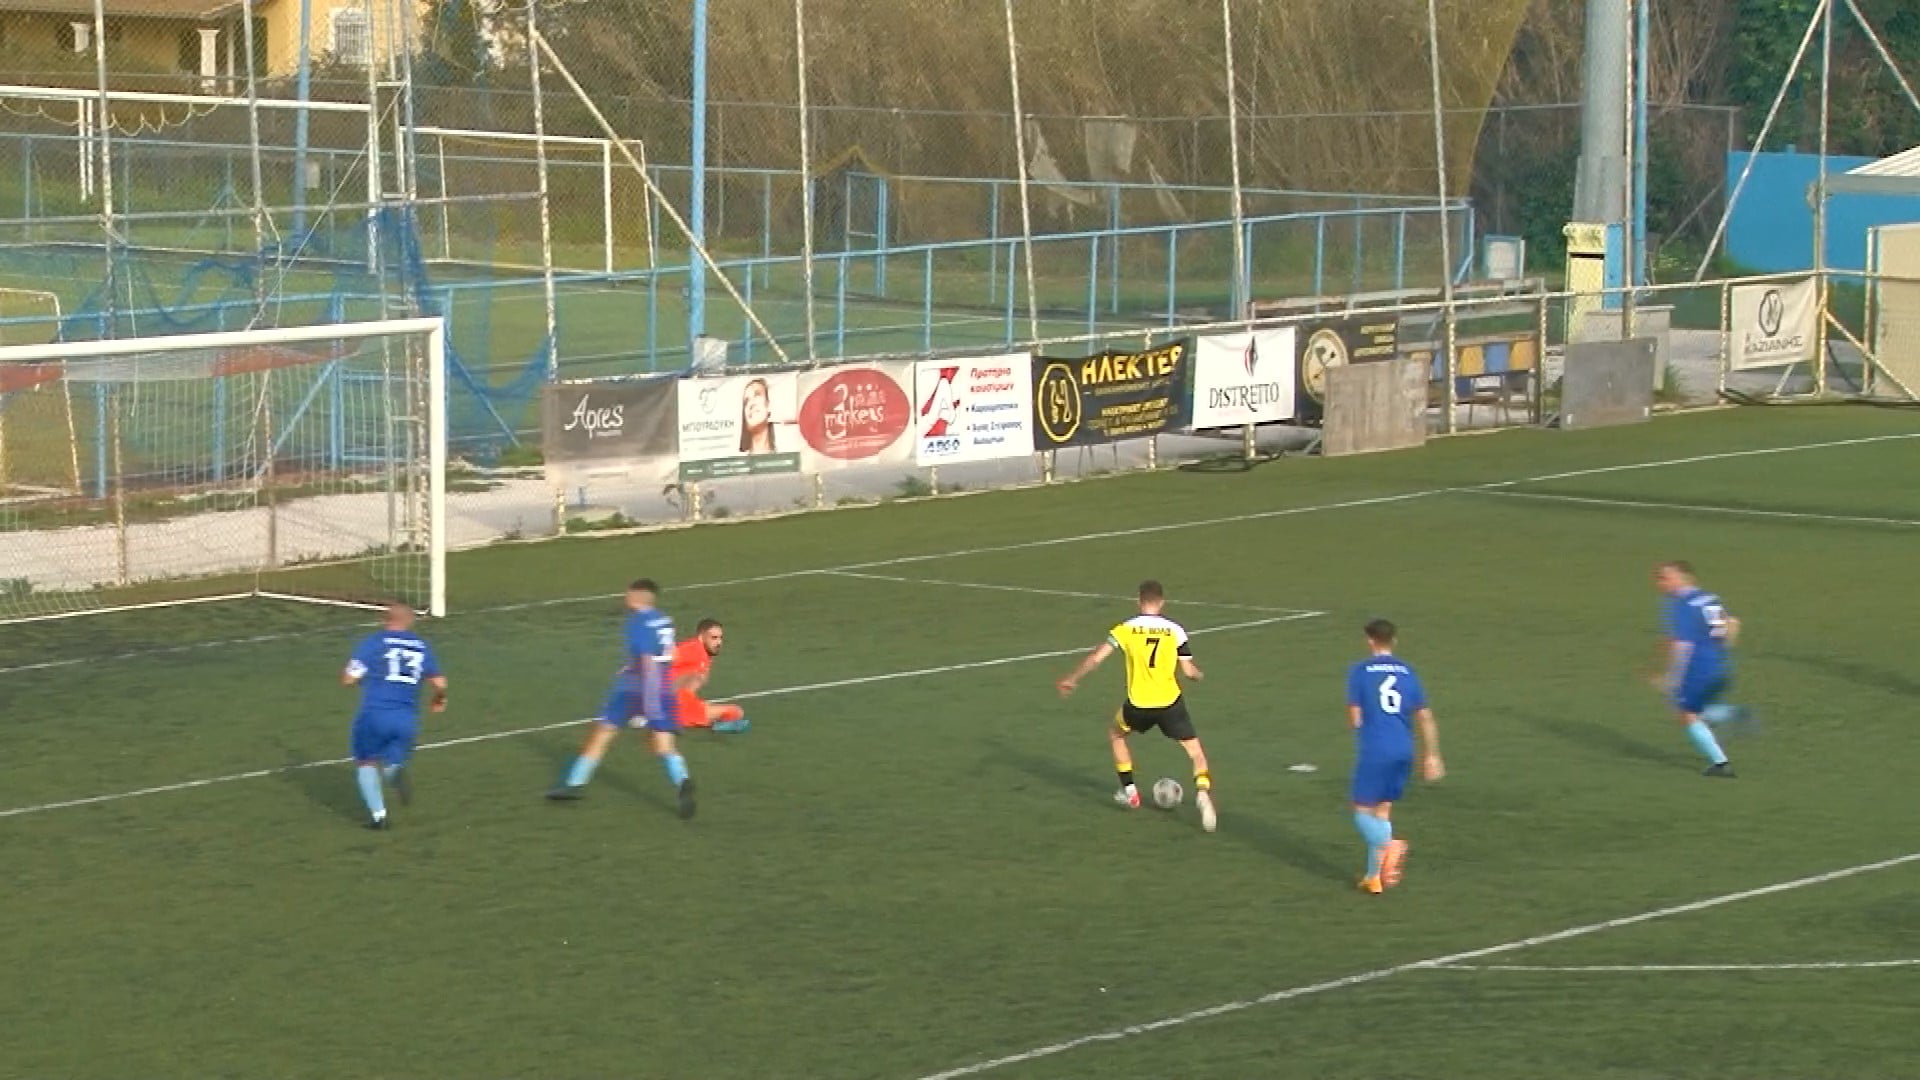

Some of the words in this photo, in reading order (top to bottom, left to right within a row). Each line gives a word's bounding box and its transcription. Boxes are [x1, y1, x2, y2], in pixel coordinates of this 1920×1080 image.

[383, 648, 425, 684] 13
[1145, 637, 1161, 669] 7
[1379, 675, 1403, 714] 6
